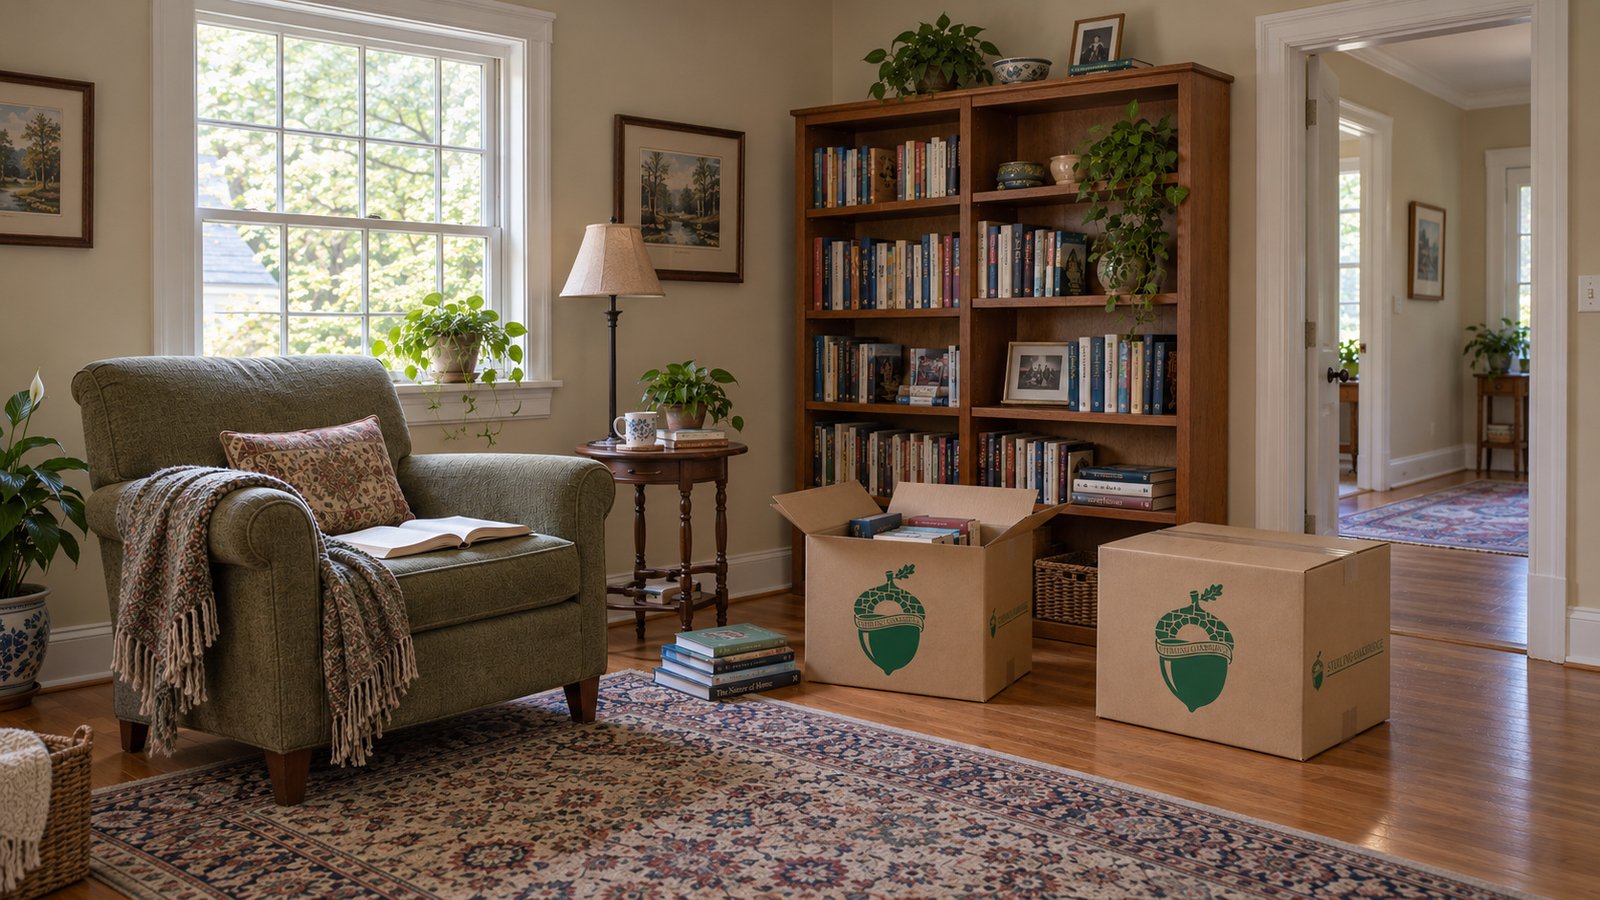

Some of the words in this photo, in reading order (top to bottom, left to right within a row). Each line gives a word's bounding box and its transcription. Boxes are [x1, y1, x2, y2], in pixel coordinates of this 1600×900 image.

[716, 688, 728, 697] The
[748, 682, 755, 691] of
[755, 680, 773, 690] Home
